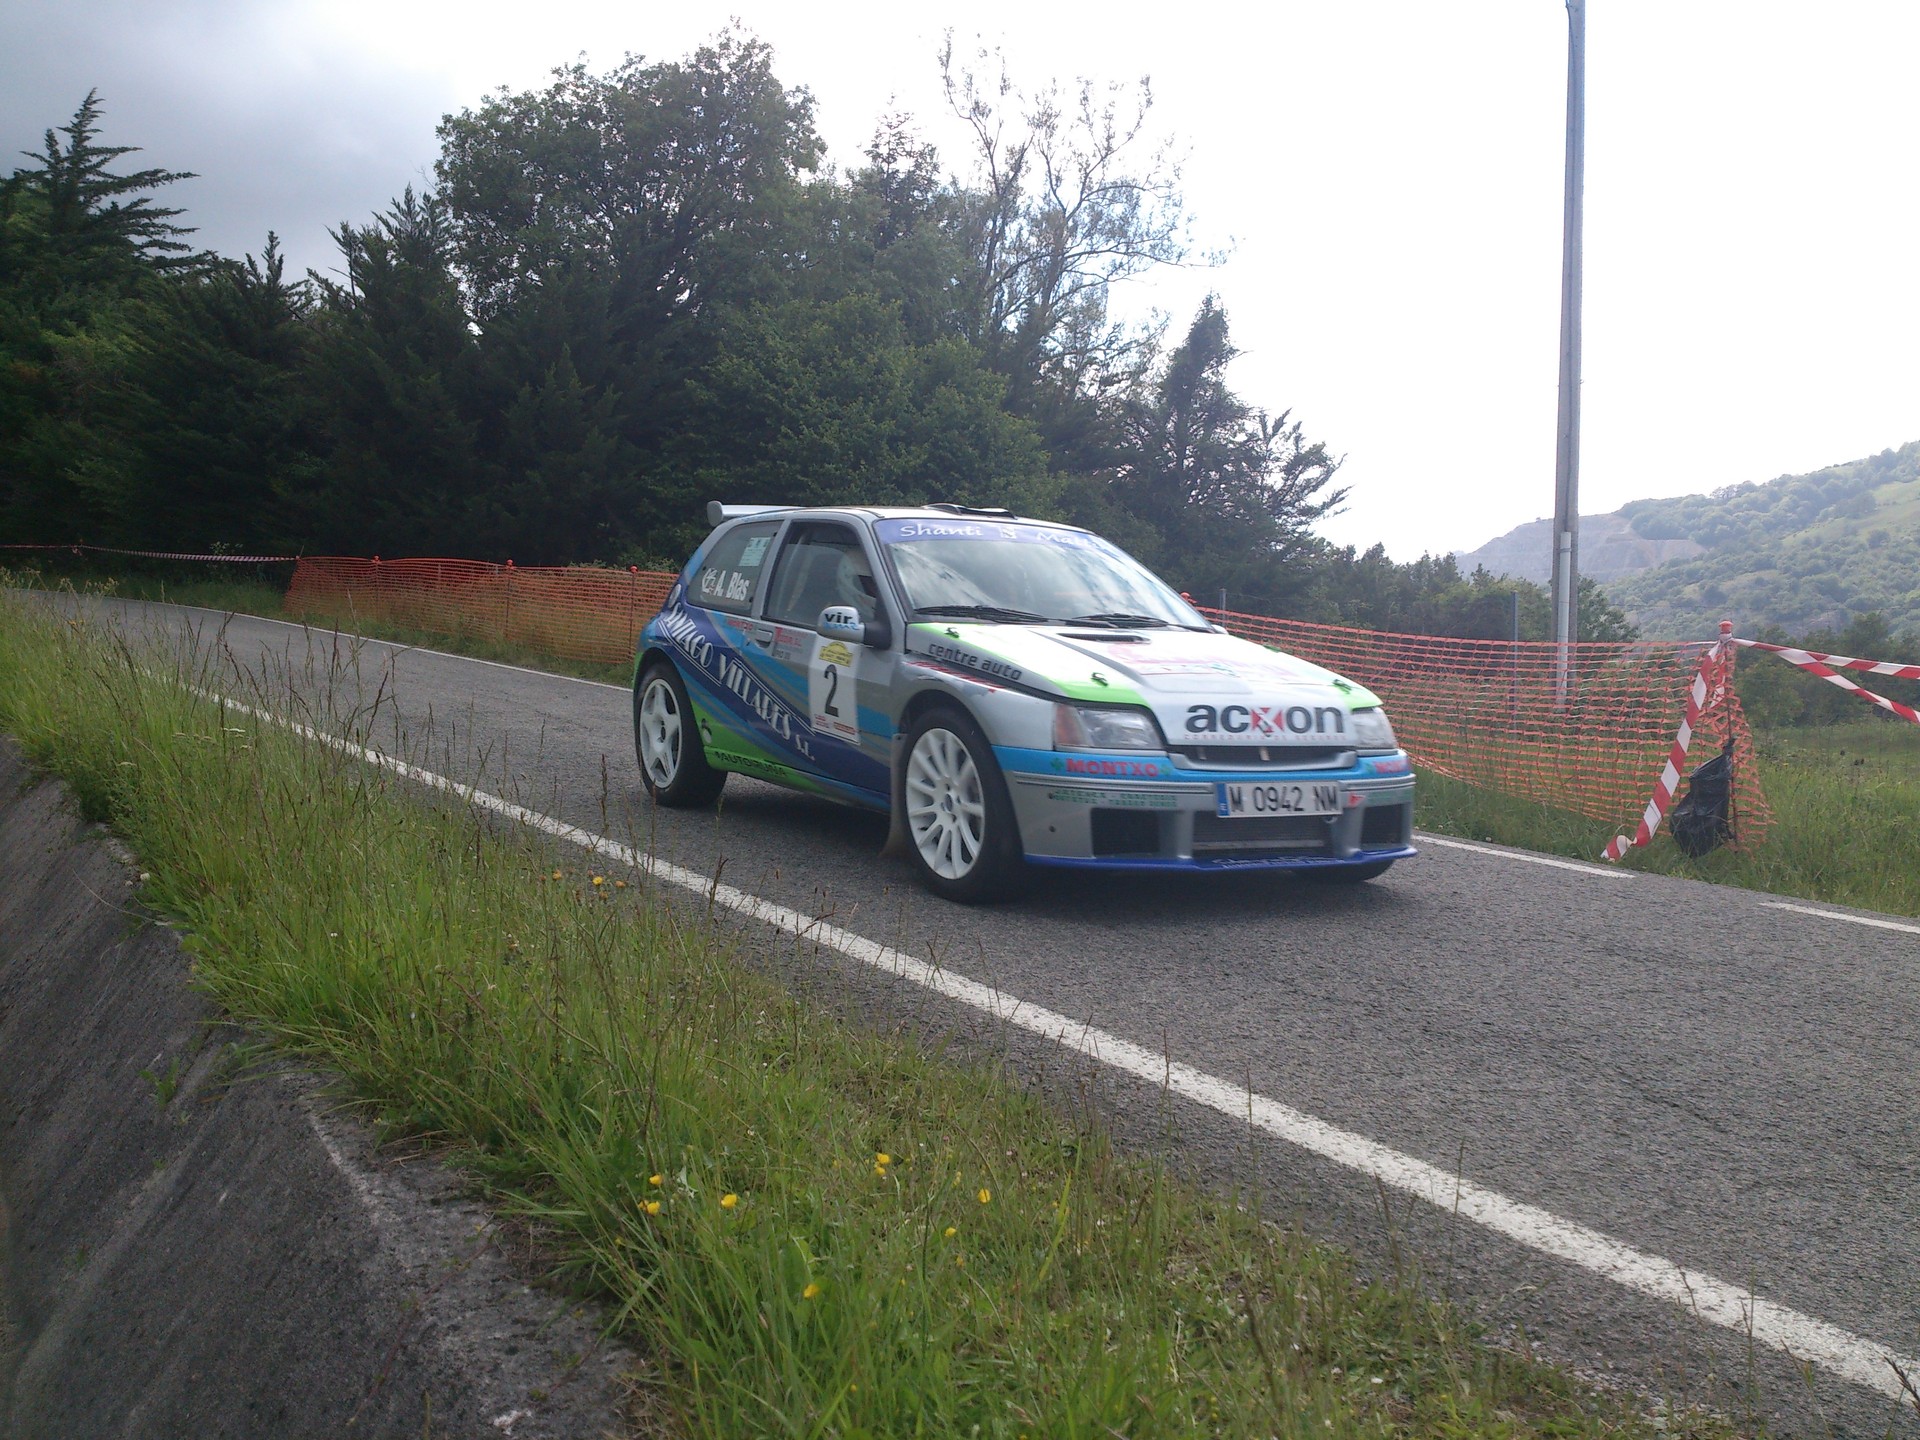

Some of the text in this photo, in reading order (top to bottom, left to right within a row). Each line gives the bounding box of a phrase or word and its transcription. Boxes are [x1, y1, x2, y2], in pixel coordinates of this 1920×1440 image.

[900, 523, 983, 538] Shanti
[726, 571, 750, 601] Blas
[825, 612, 853, 624] vir
[663, 602, 714, 668] SANTIAGO
[719, 652, 792, 740] VILLARES
[928, 643, 977, 668] centre
[981, 658, 1023, 681] auto
[823, 664, 839, 717] 2
[1066, 758, 1159, 777] MONTXO
[1253, 786, 1305, 812] 0942
